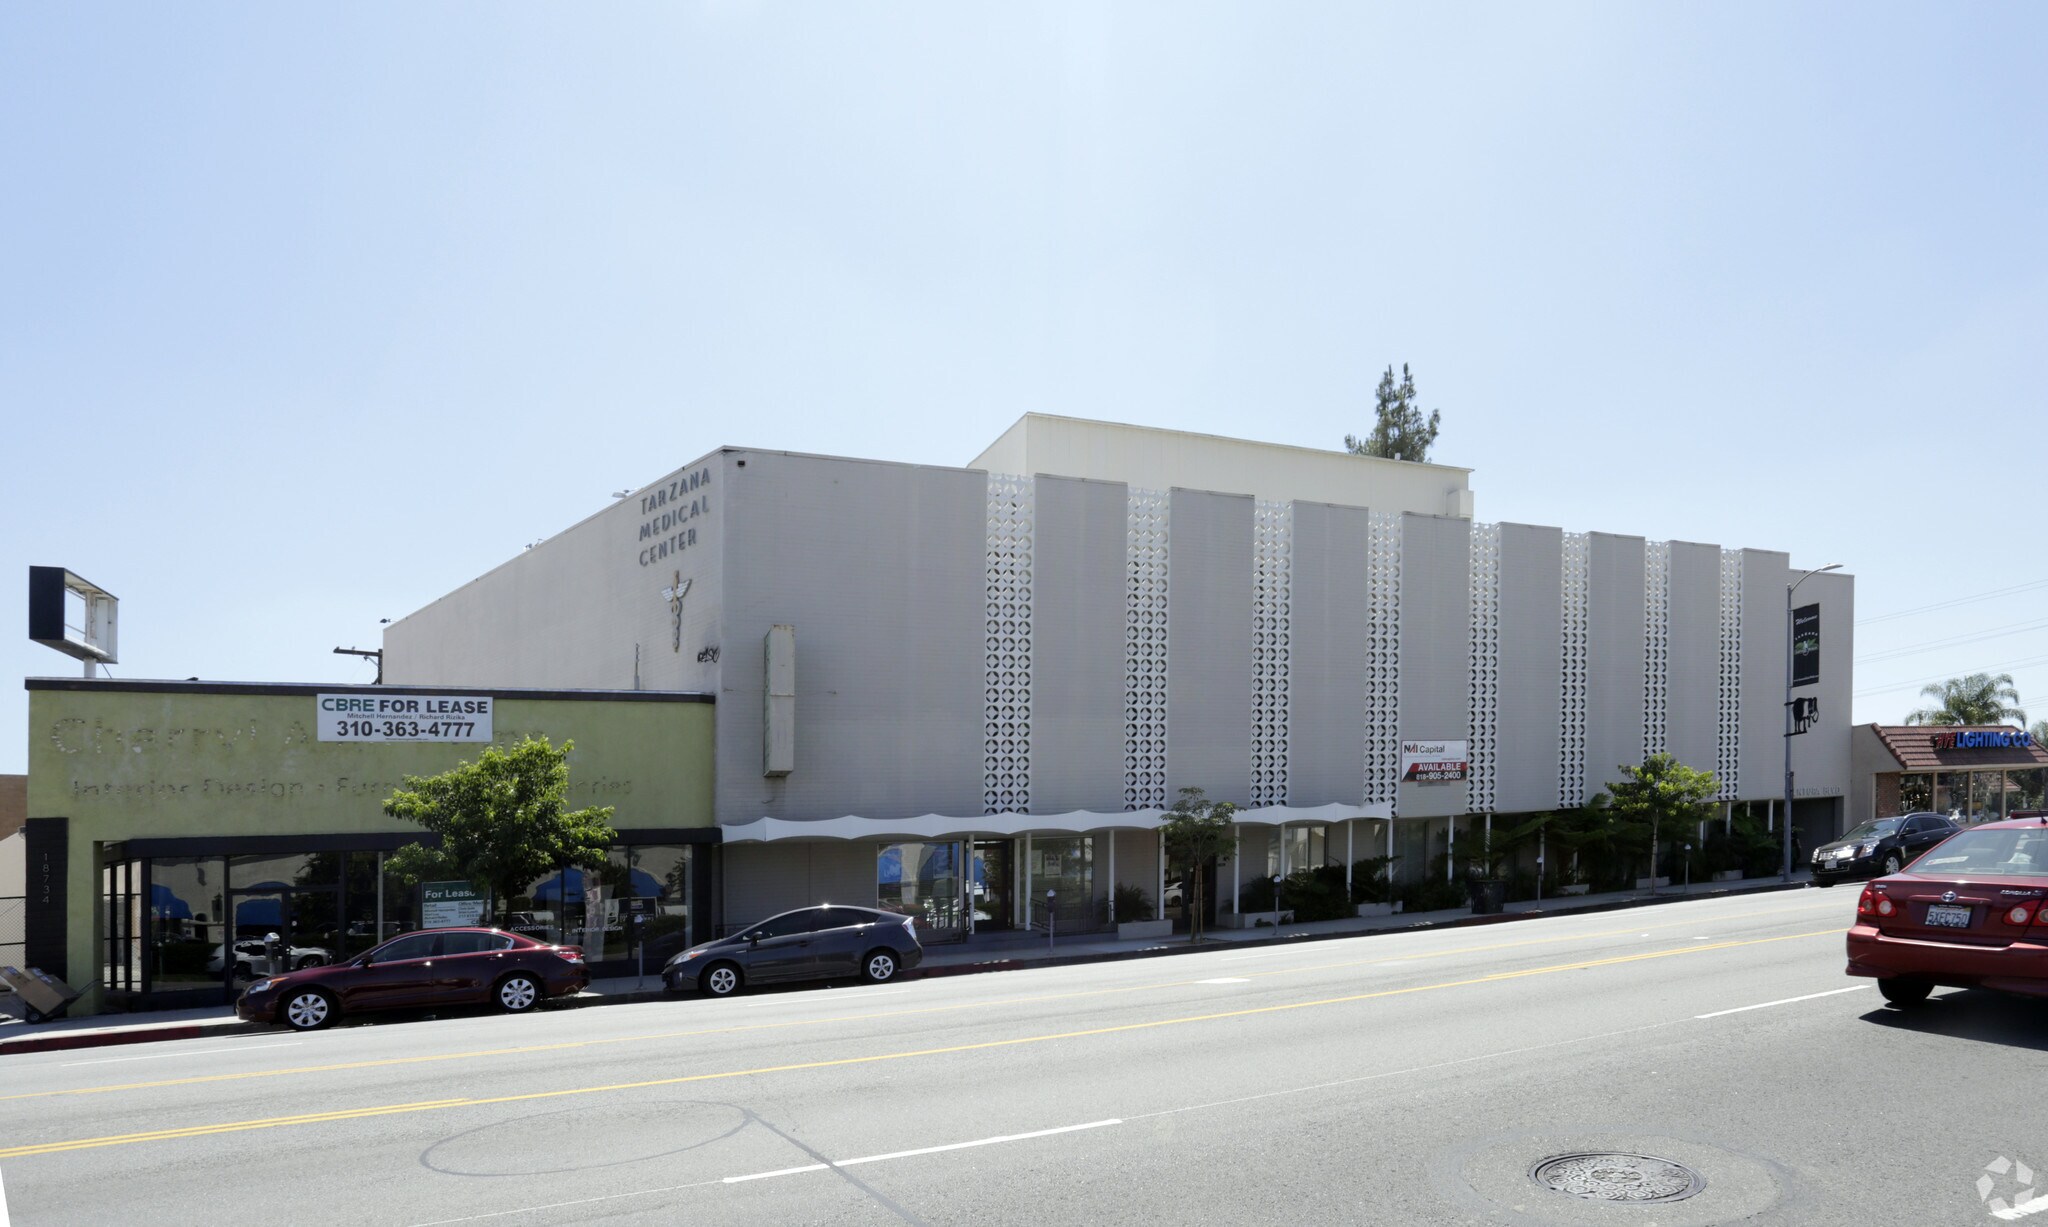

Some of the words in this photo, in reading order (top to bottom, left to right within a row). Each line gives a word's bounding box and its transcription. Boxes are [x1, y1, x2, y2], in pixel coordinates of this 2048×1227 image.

[641, 467, 711, 515] TARZANA
[639, 495, 710, 542] MEDICAL
[639, 528, 697, 567] CENTER
[322, 698, 375, 712] CBRE
[379, 699, 419, 713] FOR
[426, 700, 489, 714] LEASE
[336, 720, 475, 738] 310-363-4777
[1956, 731, 2010, 748] LIGHTING
[1403, 743, 1418, 754] NAI
[1419, 745, 1445, 754] Capital
[1418, 762, 1461, 771] AVAILABLE
[42, 852, 50, 904] 18734
[425, 890, 443, 899] For
[509, 924, 555, 933] ACCESSORIES
[571, 926, 600, 934] INTERIOR
[602, 924, 623, 932] DESIGN
